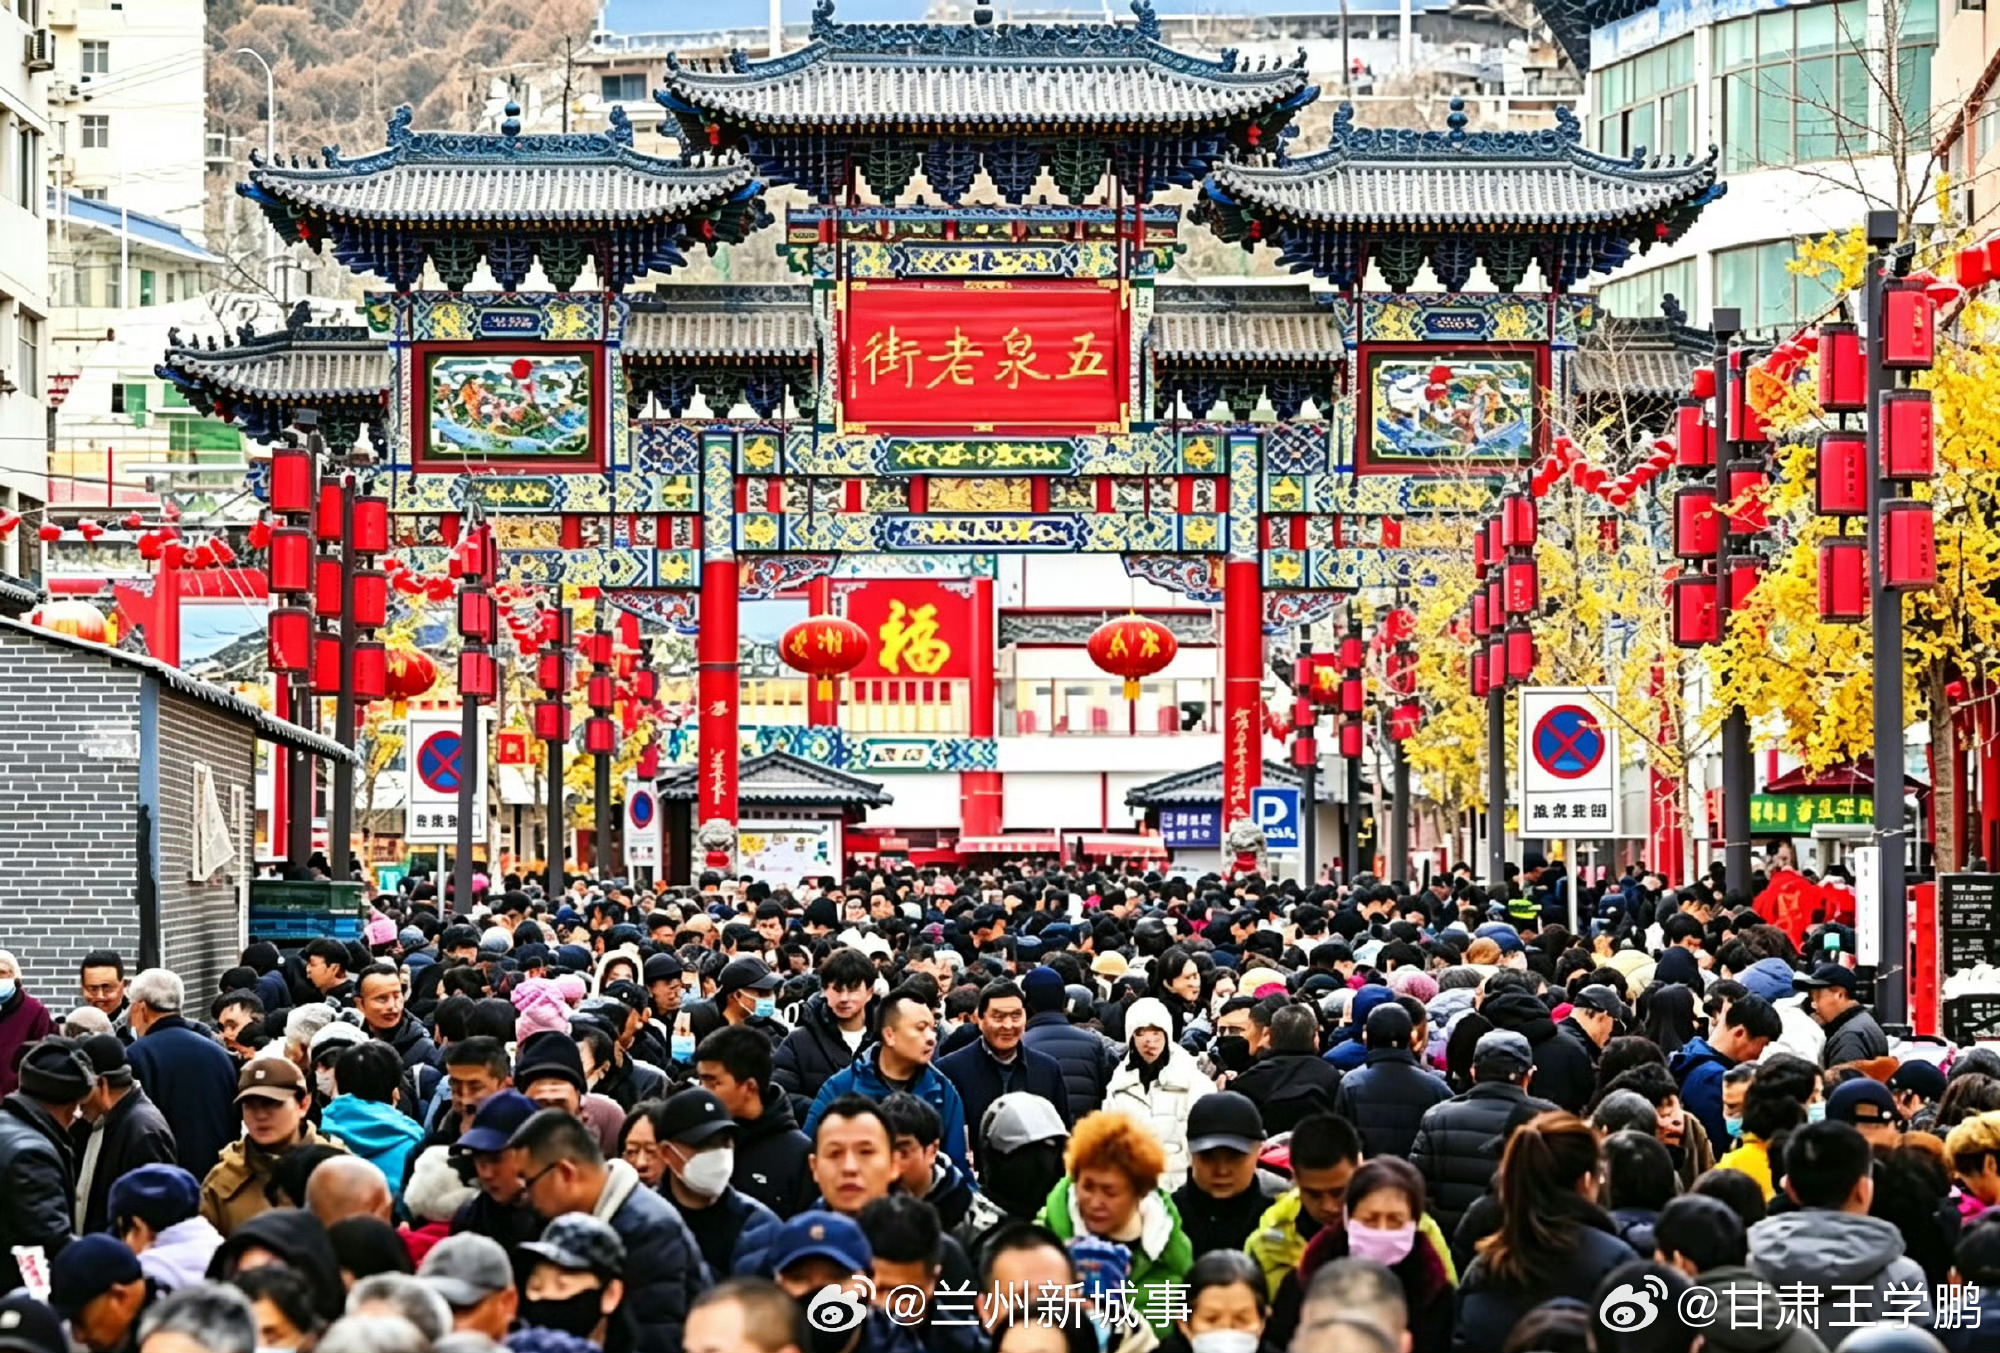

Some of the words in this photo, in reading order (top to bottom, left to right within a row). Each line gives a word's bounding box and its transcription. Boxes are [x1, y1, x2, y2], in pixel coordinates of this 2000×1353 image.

[861, 325, 1109, 390] 五泉老街
[879, 598, 951, 675] 福
[1257, 796, 1288, 827] P
